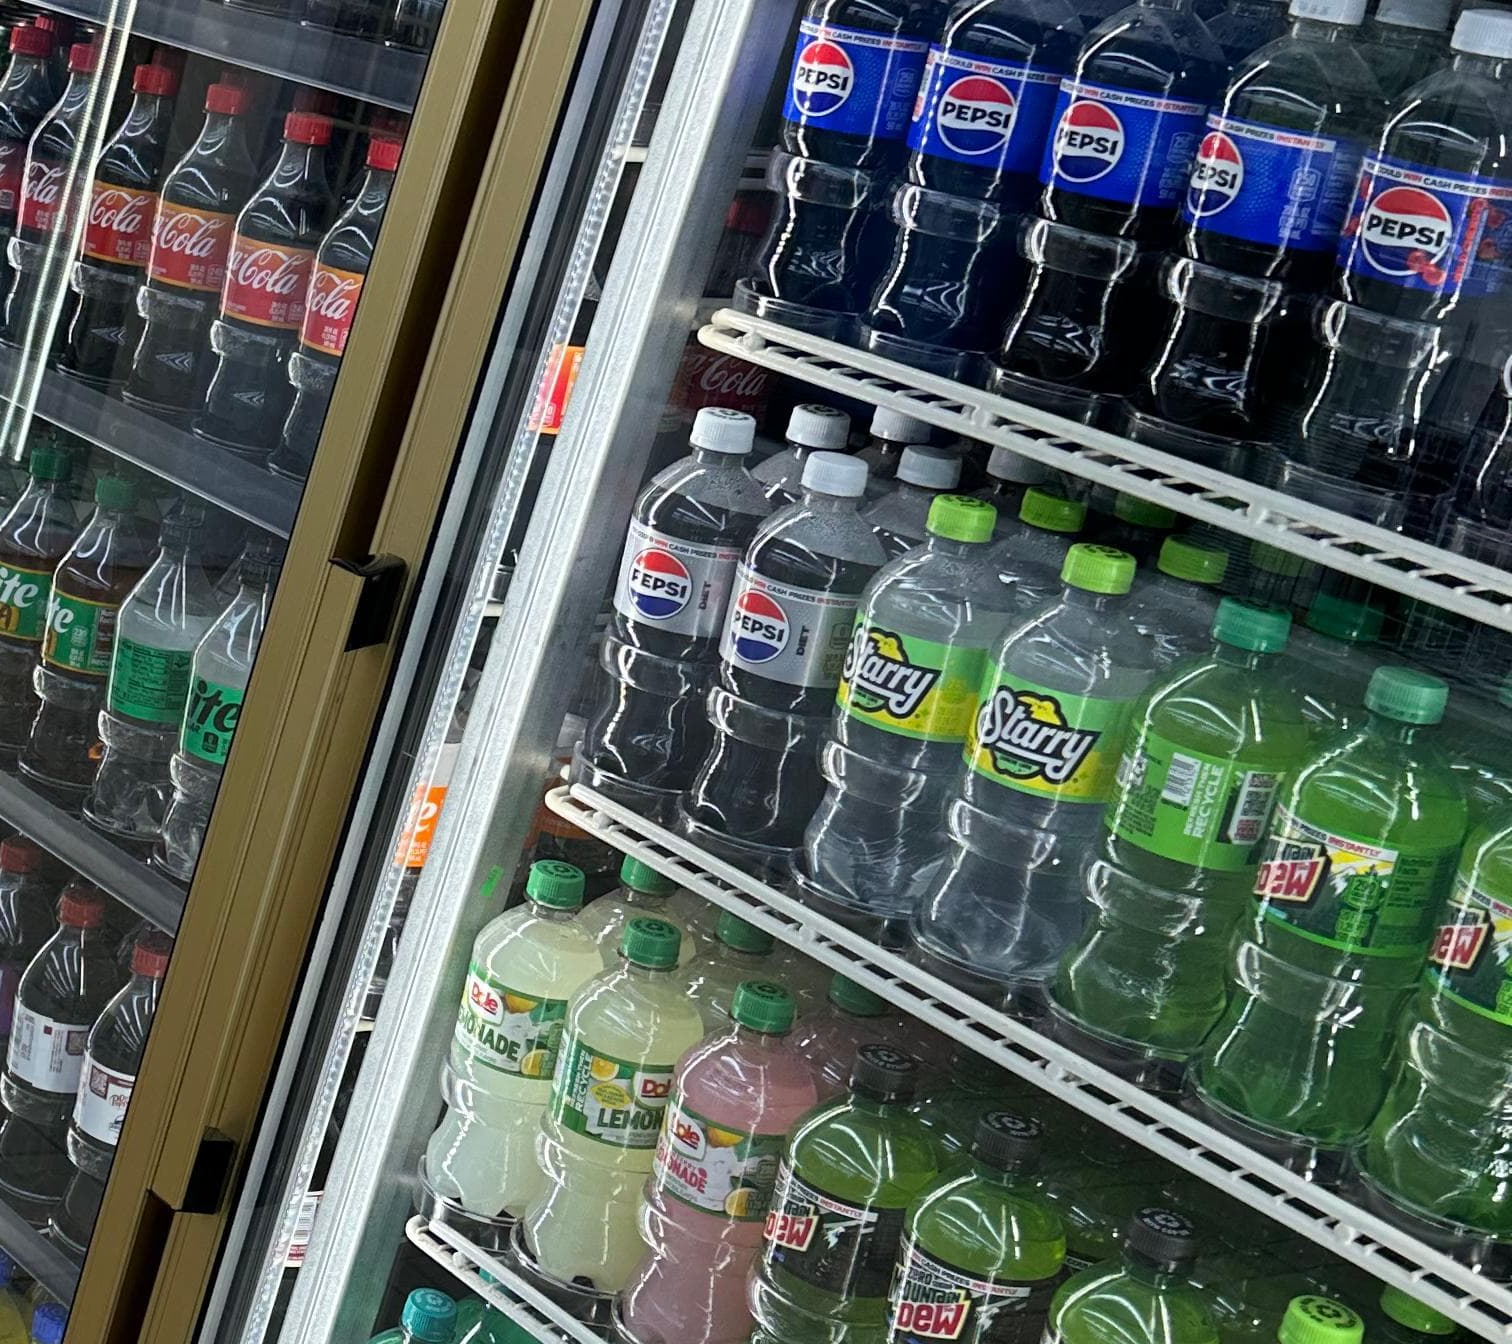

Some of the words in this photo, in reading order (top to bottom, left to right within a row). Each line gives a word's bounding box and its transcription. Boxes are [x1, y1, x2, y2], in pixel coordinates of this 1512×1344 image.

[797, 66, 850, 93] PEPSI
[992, 66, 1016, 77] CASH
[942, 101, 1011, 130] PEPSI
[1058, 127, 1119, 156] PEPSI
[25, 162, 65, 204] ola
[1192, 159, 1236, 190] PEPSI
[1423, 177, 1451, 189] CASH
[91, 190, 150, 233] Cola
[159, 213, 226, 258] Cola
[1368, 213, 1446, 248] PEPSI
[238, 248, 309, 295] Cola
[631, 568, 688, 598] PEPSI
[734, 611, 784, 643] PEPSI
[795, 625, 810, 656] DIET
[843, 627, 937, 715] Starry
[977, 689, 1092, 780] Starry
[1192, 764, 1225, 838] RECYCLE
[641, 1078, 672, 1096] Dol
[597, 1107, 665, 1131] LEMON
